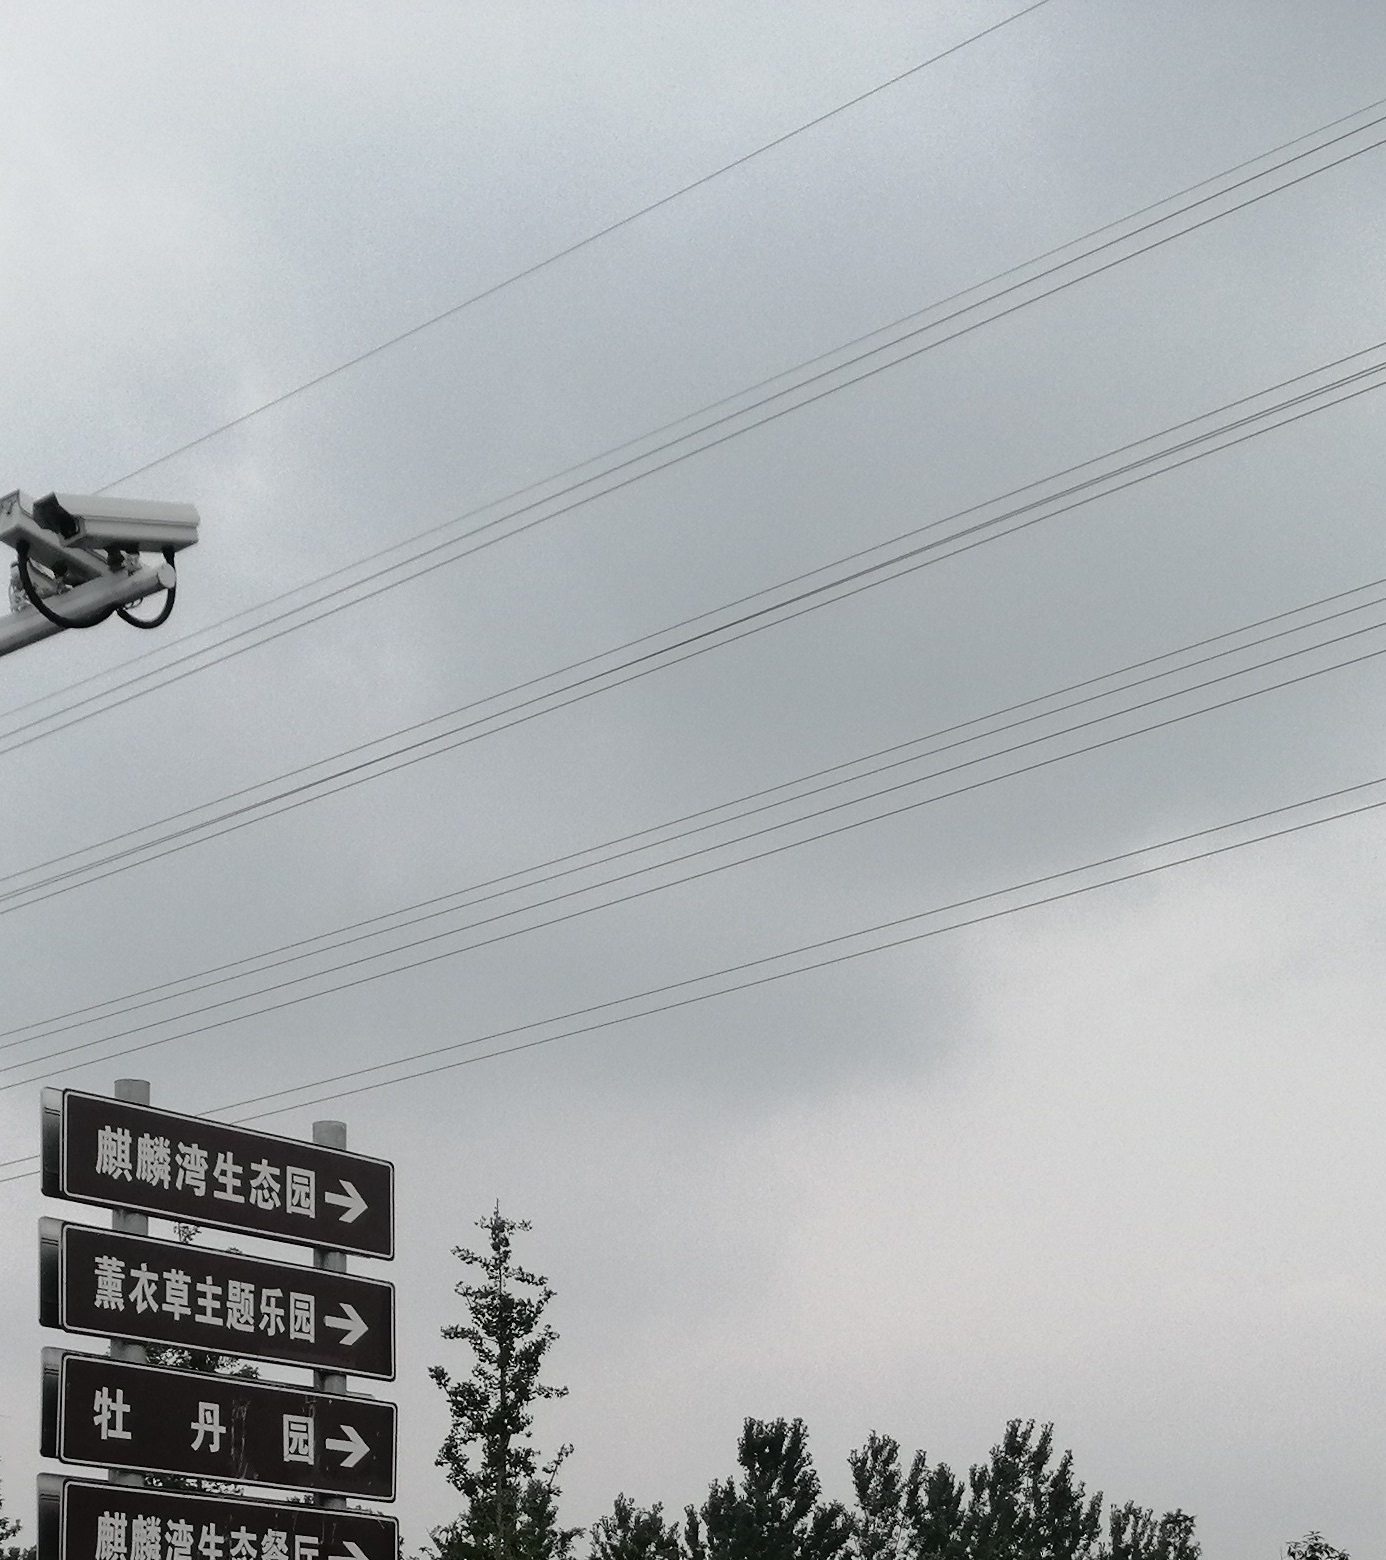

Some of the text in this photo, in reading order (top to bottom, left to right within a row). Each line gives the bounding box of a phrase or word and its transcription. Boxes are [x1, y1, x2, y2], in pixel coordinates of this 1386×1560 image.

[95, 1125, 316, 1219] 麒麟湾生态园
[94, 1255, 316, 1344] 薰衣草主题乐园
[93, 1386, 315, 1466] 牡丹园
